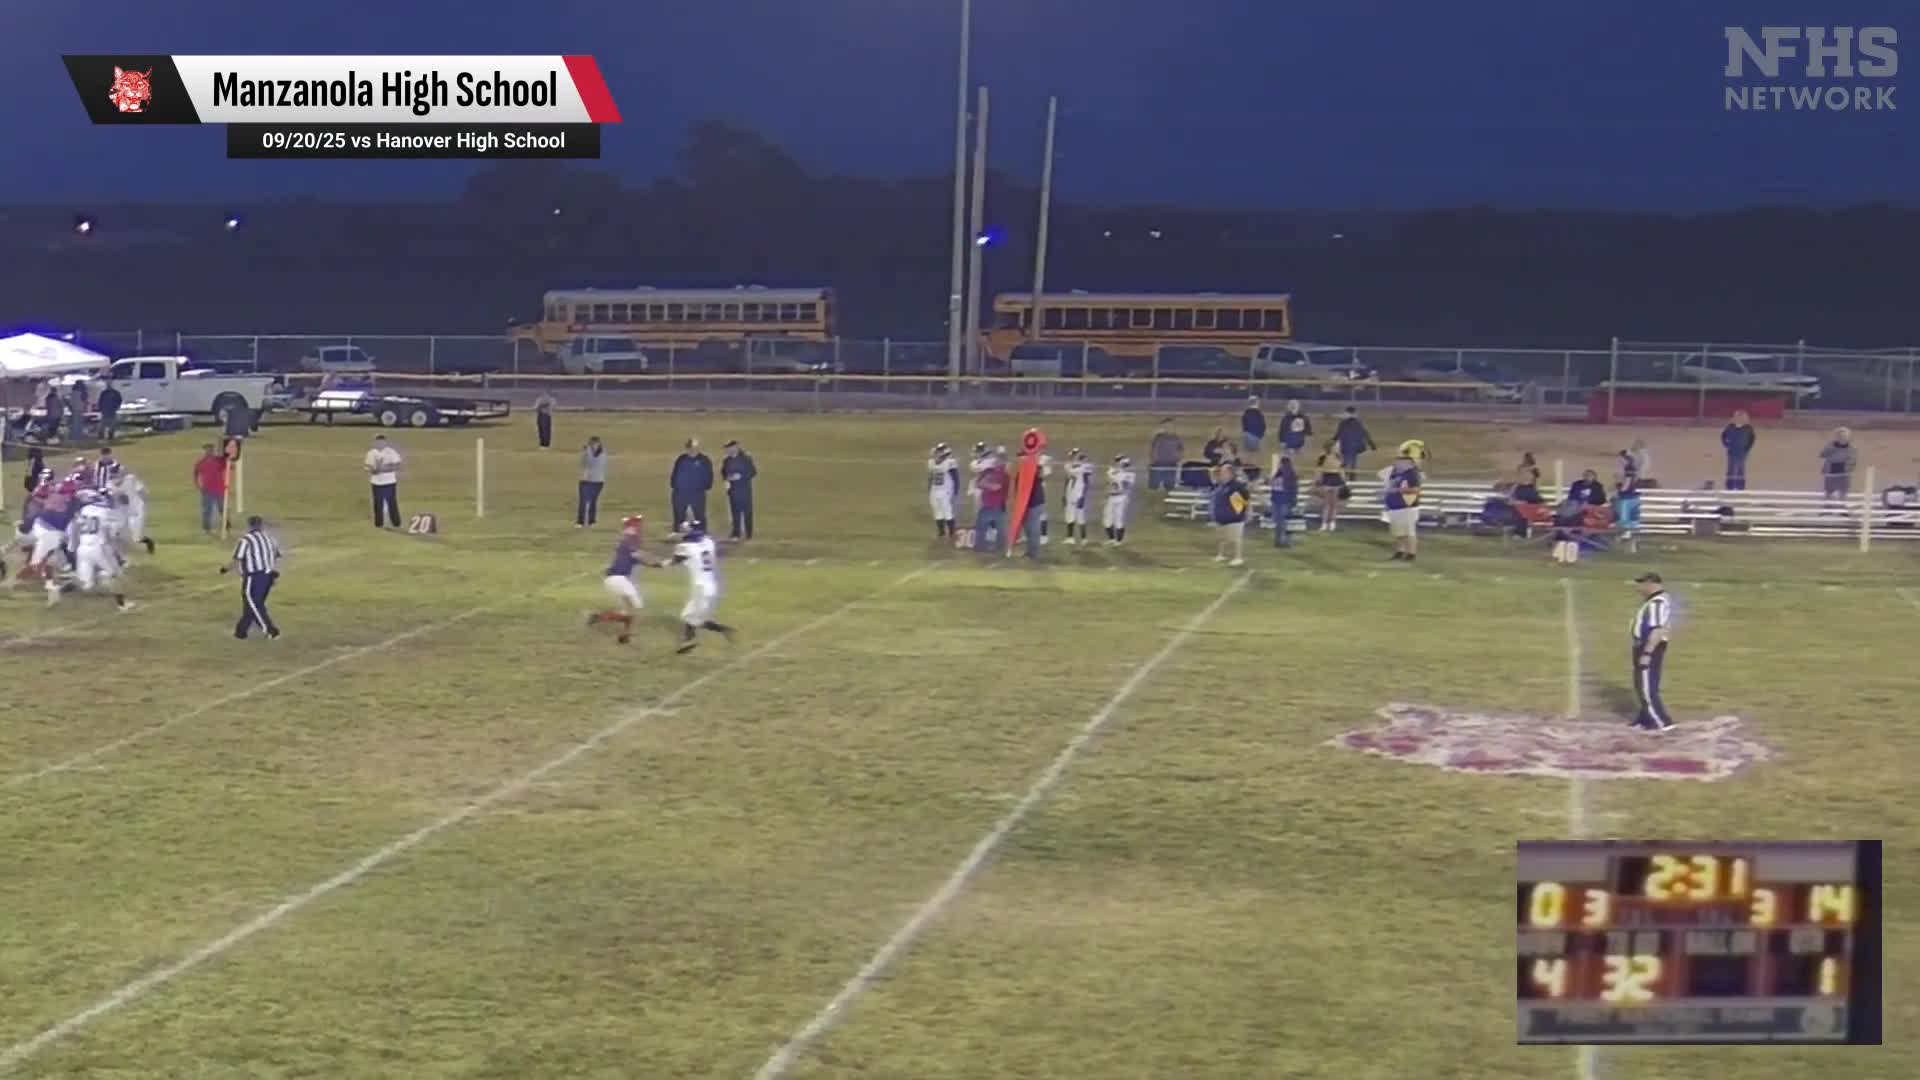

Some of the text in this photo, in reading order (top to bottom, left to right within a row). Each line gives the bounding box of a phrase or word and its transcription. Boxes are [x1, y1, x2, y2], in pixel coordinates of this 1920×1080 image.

[409, 515, 431, 534] 20
[954, 528, 976, 549] 30
[1552, 541, 1579, 563] 40
[1644, 854, 1749, 900] 2:31
[1529, 881, 1565, 926] 0
[1581, 889, 1610, 926] 3
[1750, 889, 1776, 925] 3
[1807, 884, 1856, 925] 14
[1532, 958, 1567, 996] 4
[1601, 955, 1662, 1002] 32
[1818, 957, 1837, 995] 1
